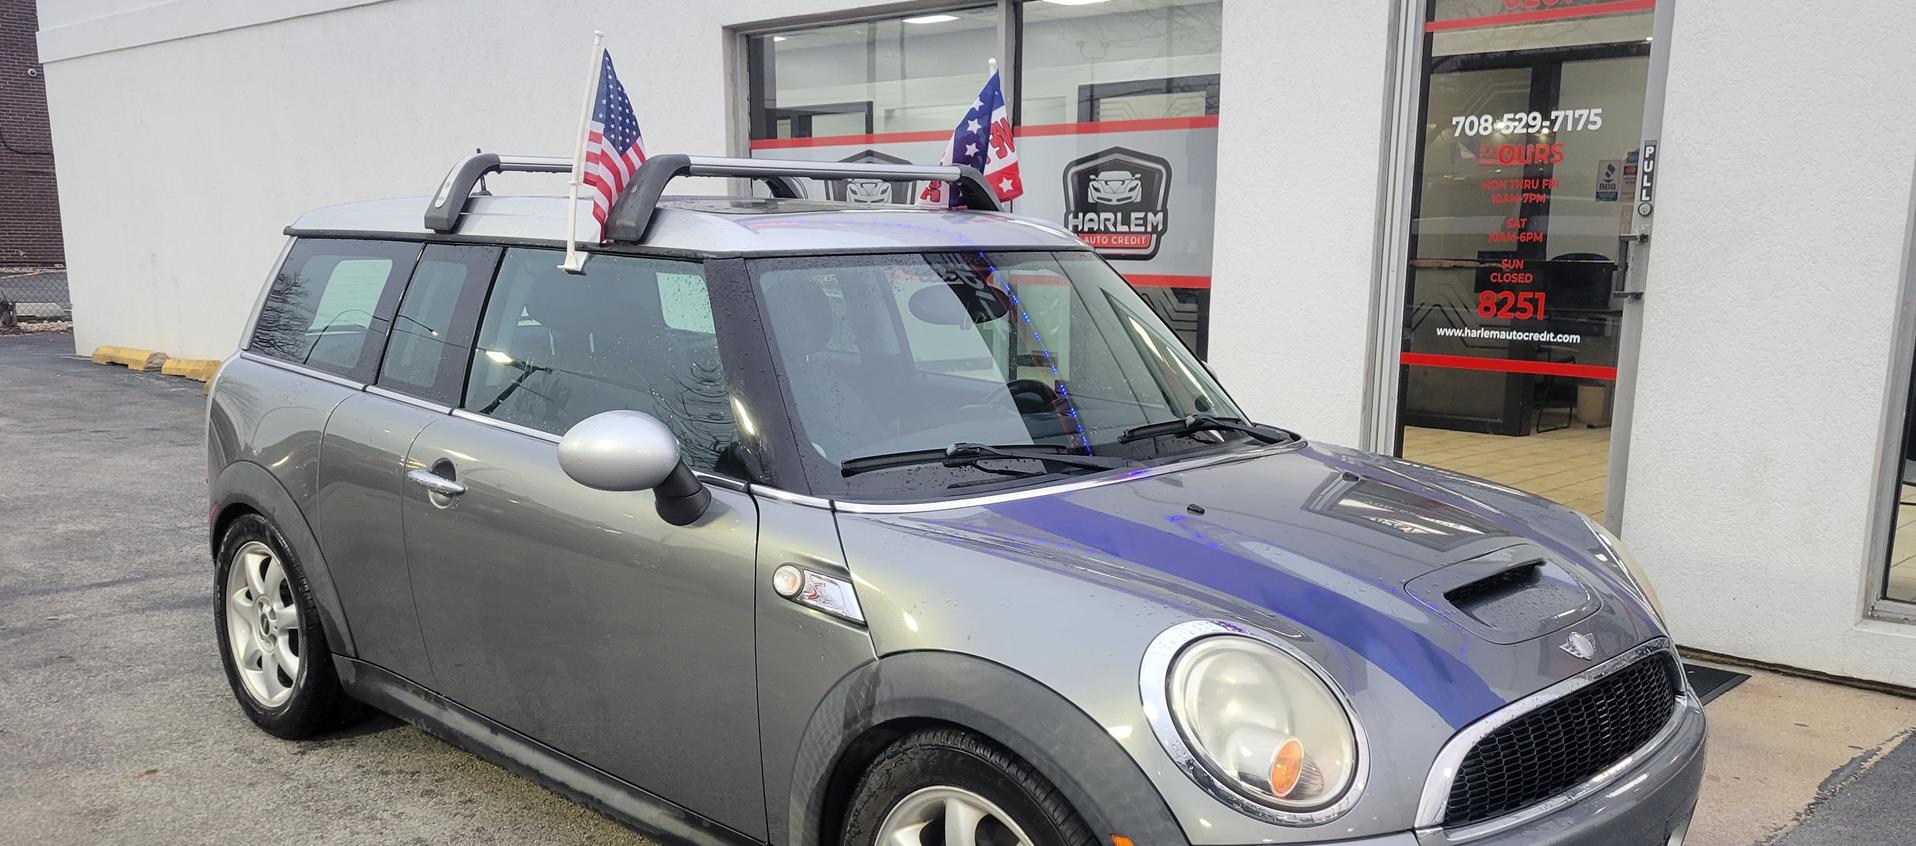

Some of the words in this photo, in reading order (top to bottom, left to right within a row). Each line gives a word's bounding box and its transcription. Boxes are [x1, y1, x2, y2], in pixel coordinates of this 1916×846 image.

[1452, 108, 1602, 137] 708-529-7175
[1641, 146, 1655, 201] PULL
[1510, 178, 1539, 190] THRU
[1599, 183, 1617, 191] BBB
[1068, 212, 1164, 233] HARLEM
[1506, 218, 1528, 229] SAT
[1084, 236, 1108, 245] AUTO
[1111, 236, 1146, 245] CREDIT
[1488, 232, 1543, 243] 10AM-6PM
[1501, 258, 1524, 270] SUN
[1490, 272, 1534, 284] CLOSED
[1476, 290, 1546, 321] 8251
[1436, 326, 1581, 344] www.harlemautocredit.com
